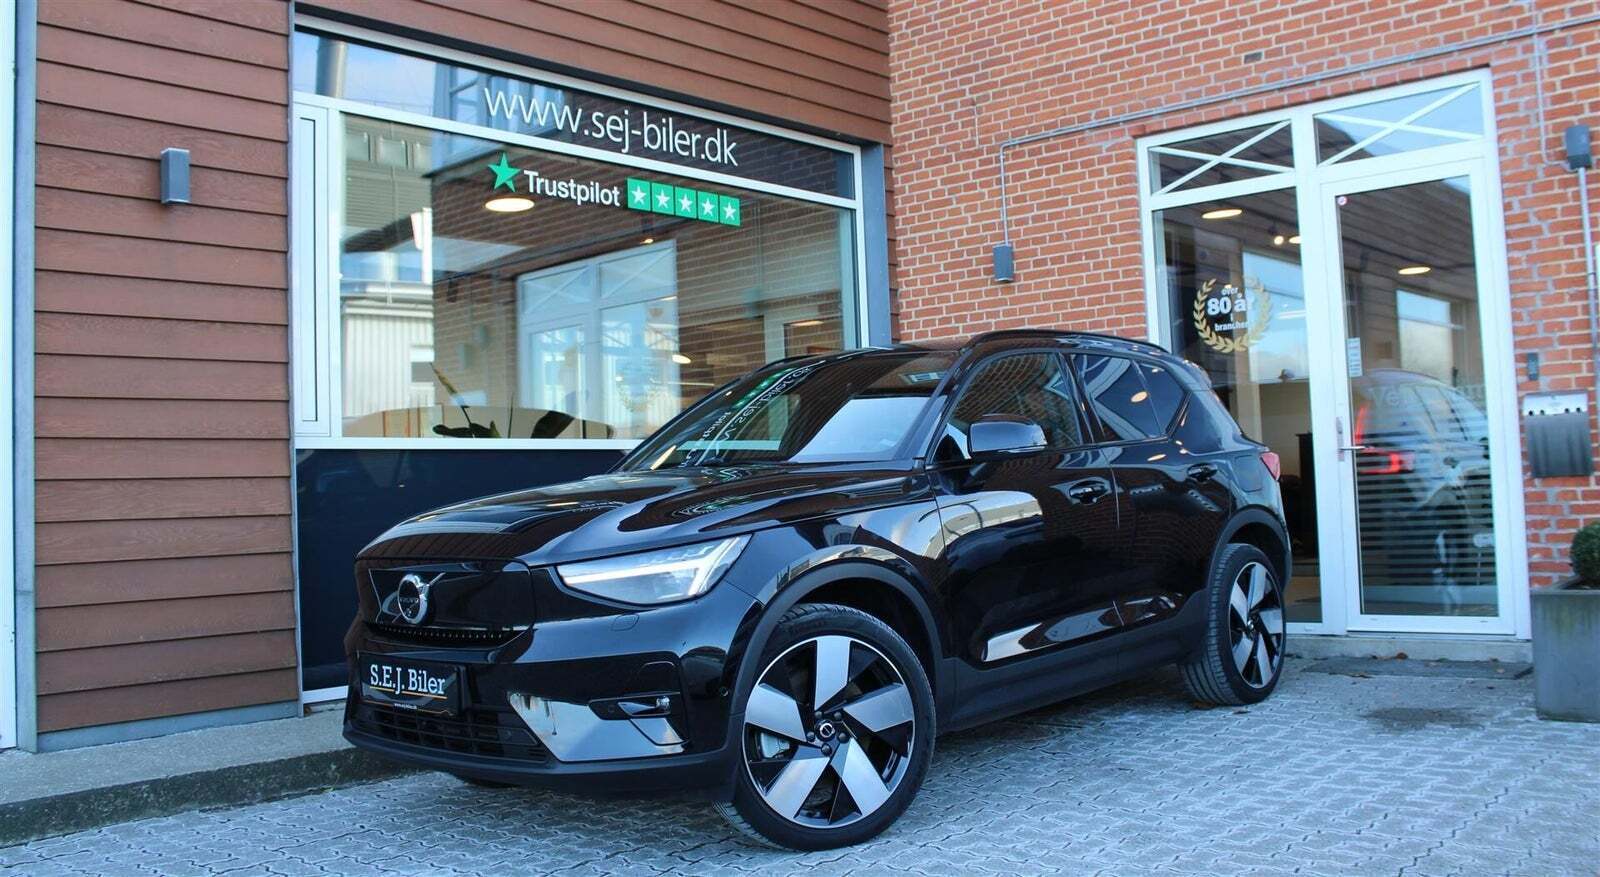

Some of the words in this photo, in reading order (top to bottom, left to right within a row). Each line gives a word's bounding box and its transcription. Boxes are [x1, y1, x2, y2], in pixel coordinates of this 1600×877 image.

[484, 87, 739, 167] www.sej-biler.dk
[523, 169, 621, 207] Trustpilot
[1207, 296, 1232, 316] 80
[1221, 287, 1239, 296] over
[370, 663, 405, 695] S.E.J.
[407, 668, 446, 695] Biler
